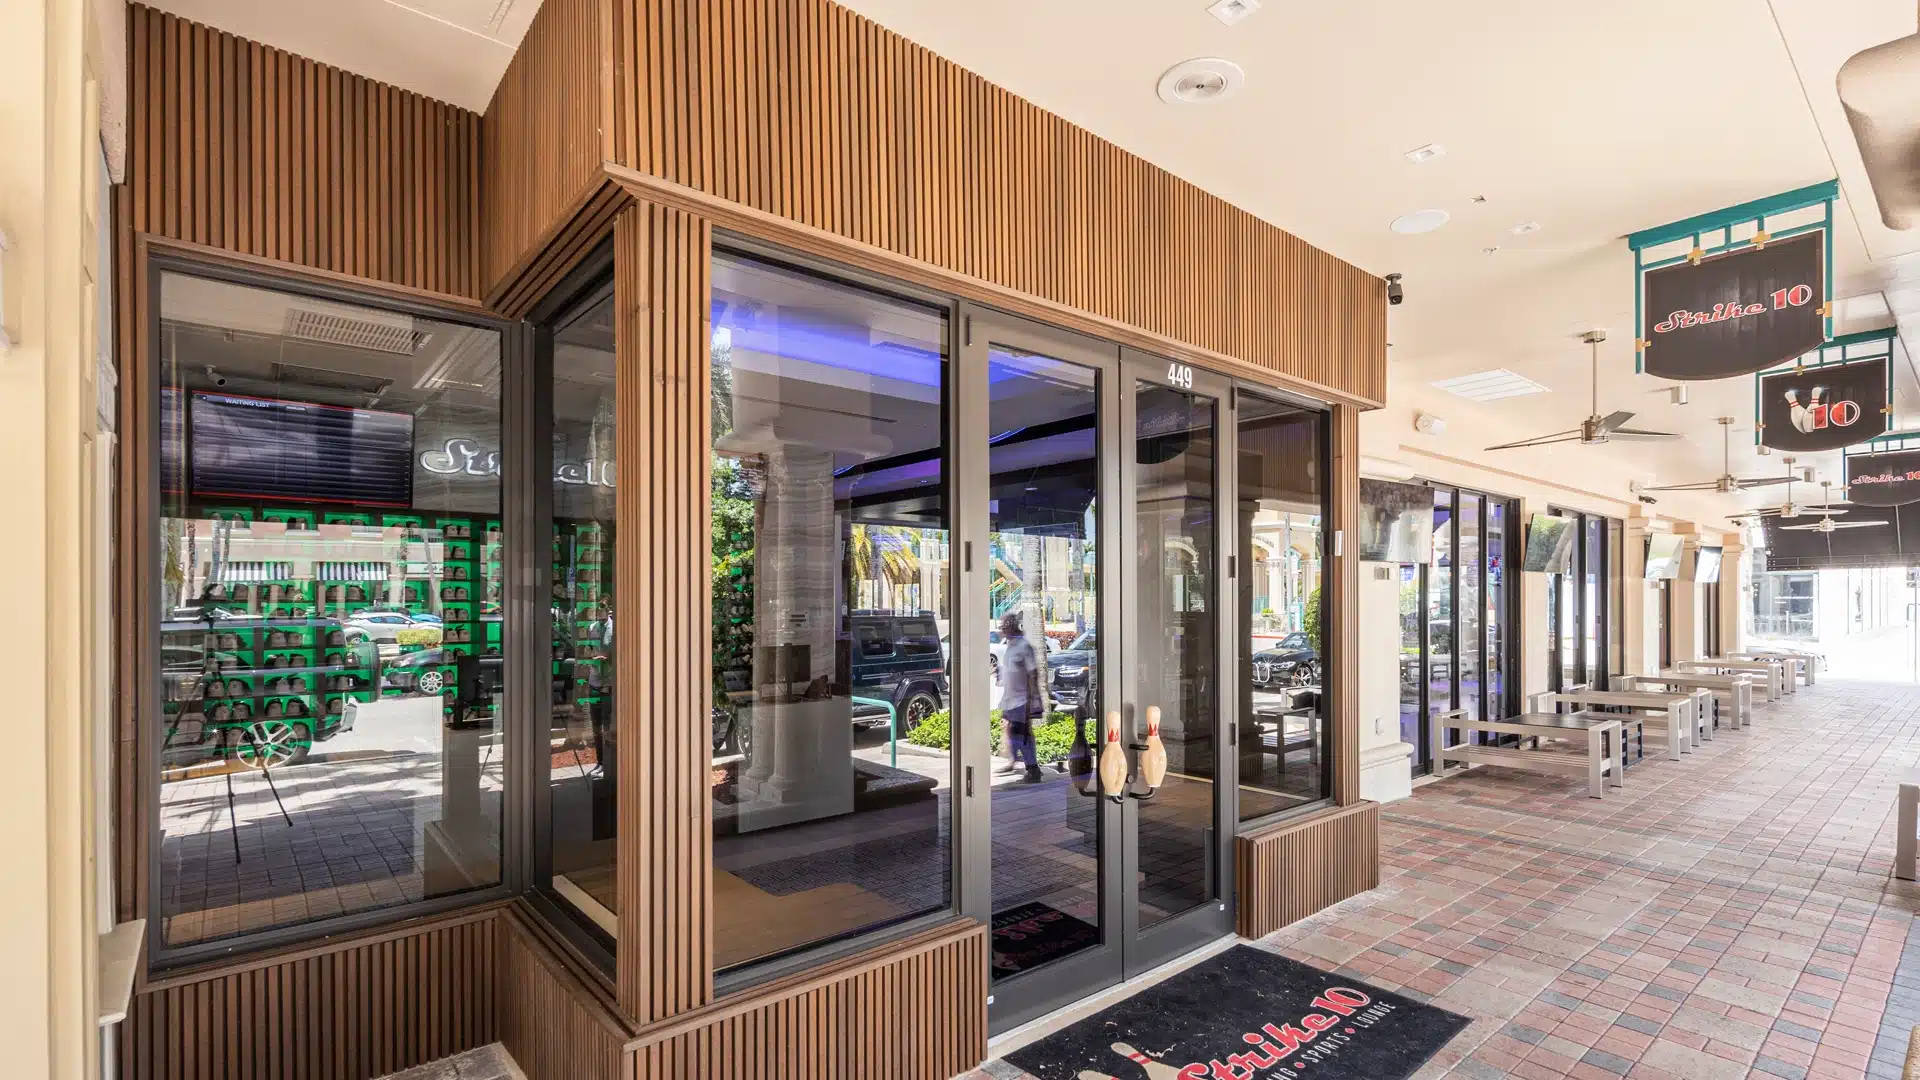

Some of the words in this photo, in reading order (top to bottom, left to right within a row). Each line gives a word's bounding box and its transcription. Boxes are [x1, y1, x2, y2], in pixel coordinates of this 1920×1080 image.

[1654, 302, 1767, 333] Strike
[1770, 284, 1813, 310] 10
[1167, 363, 1193, 389] 449
[225, 398, 255, 407] WAITING
[1809, 400, 1860, 430] 10
[1302, 1032, 1350, 1062] SPORTS
[1351, 1001, 1397, 1029] LOUNGE
